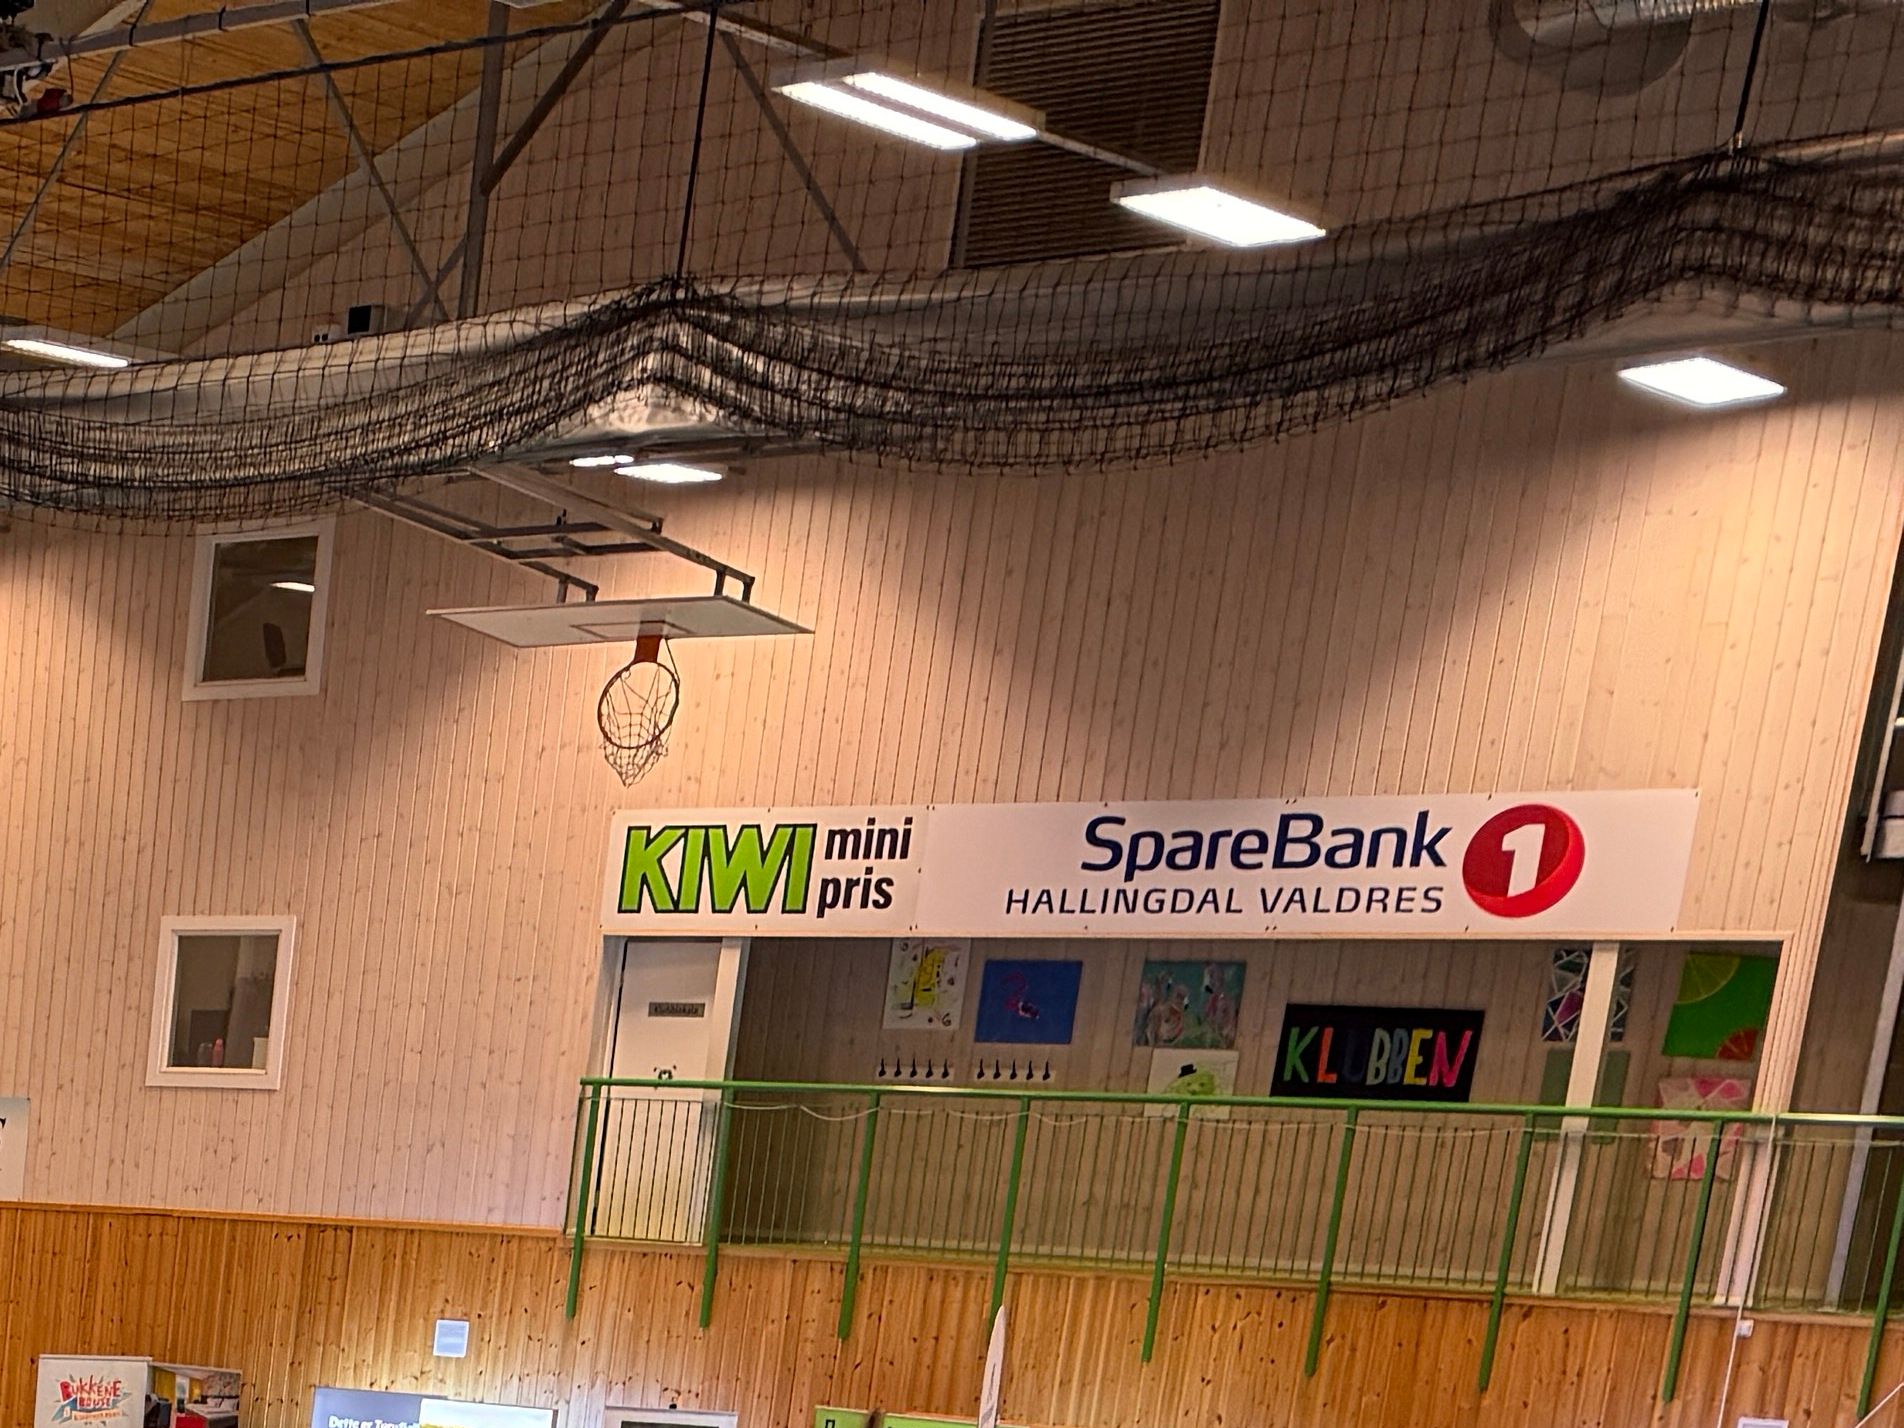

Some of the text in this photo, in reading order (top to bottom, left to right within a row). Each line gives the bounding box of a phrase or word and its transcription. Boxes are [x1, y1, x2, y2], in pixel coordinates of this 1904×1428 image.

[825, 816, 913, 862] mini
[1082, 811, 1448, 882] SpareBank
[619, 823, 818, 915] KIWI
[817, 871, 894, 922] pris
[1005, 886, 1444, 916] HALLINGDAL VALDRES
[1283, 1025, 1473, 1087] KLUBBEN
